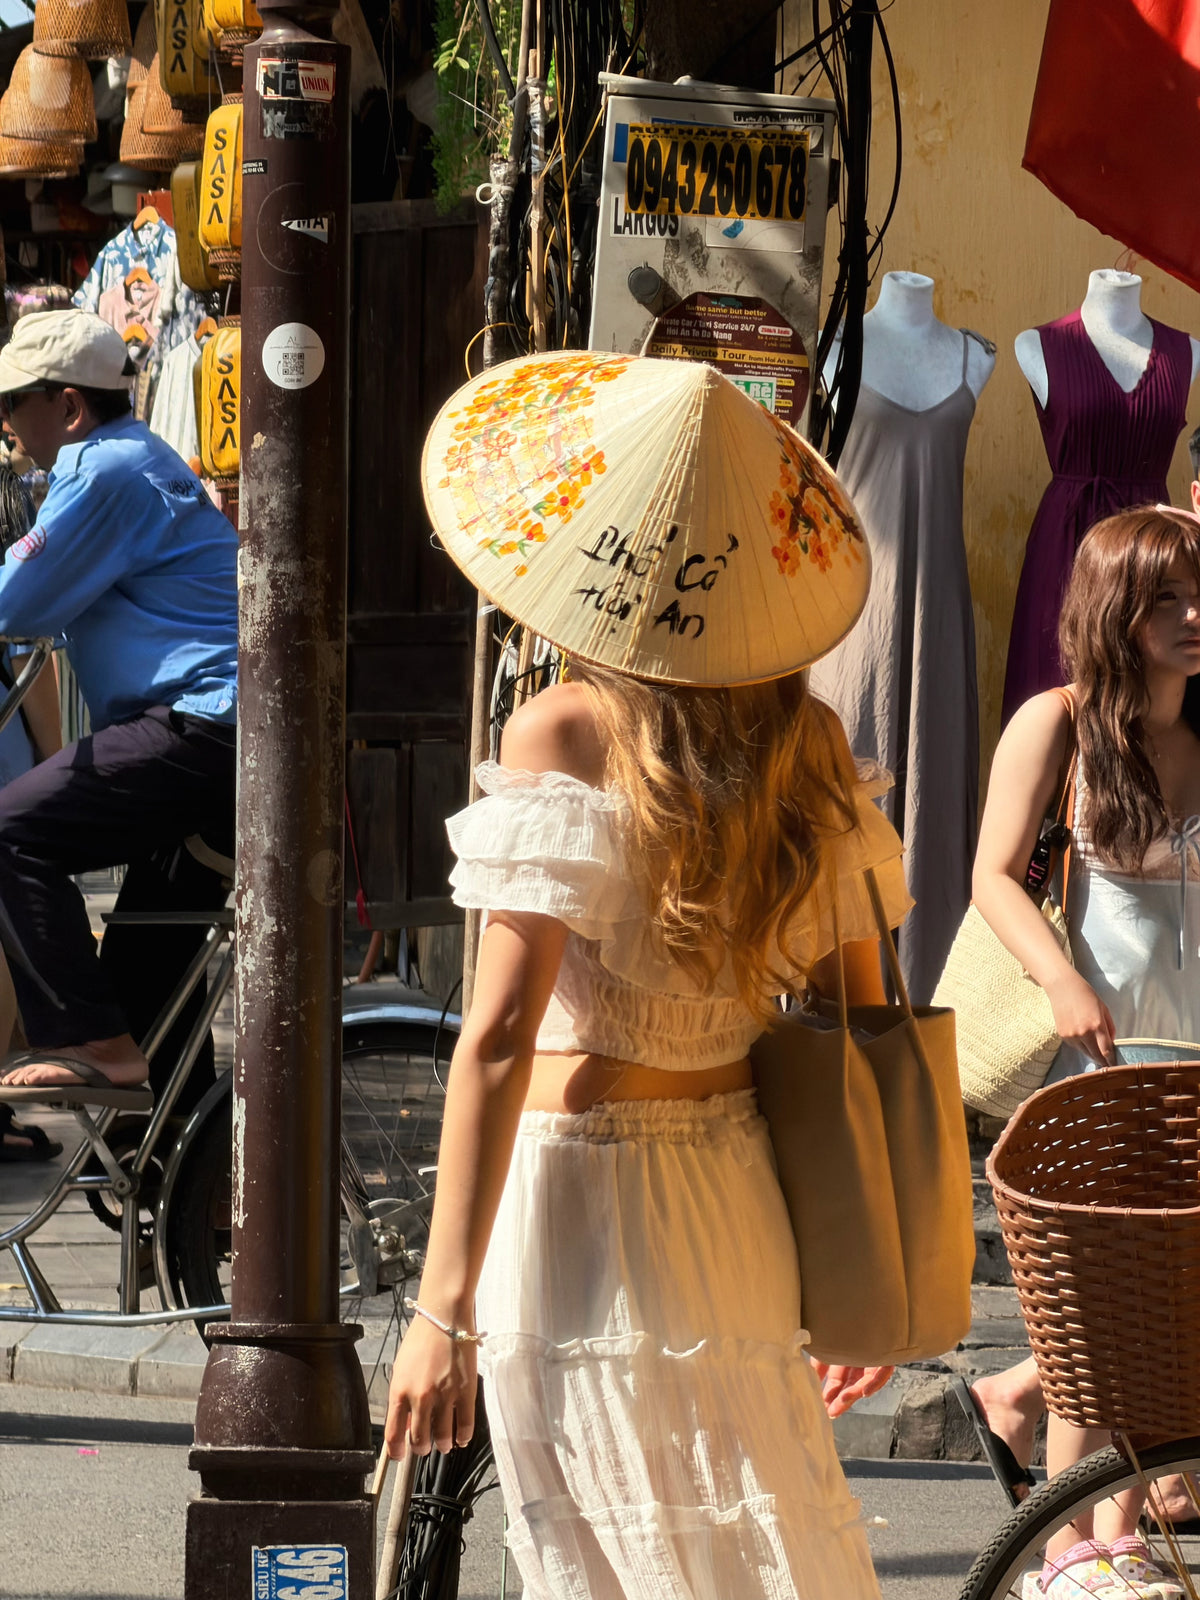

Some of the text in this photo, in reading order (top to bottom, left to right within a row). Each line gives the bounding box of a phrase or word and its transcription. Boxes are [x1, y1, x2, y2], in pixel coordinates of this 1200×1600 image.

[301, 76, 330, 92] UNION
[627, 139, 806, 218] 0943.260.678
[744, 309, 767, 318] better
[681, 318, 693, 327] Car
[713, 321, 739, 330] Service
[740, 324, 756, 332] 24/7
[713, 331, 732, 340] Nang
[651, 344, 678, 357] Daily
[681, 346, 718, 358] Private
[721, 349, 746, 360] Tour
[748, 355, 763, 363] from
[652, 600, 705, 639] An
